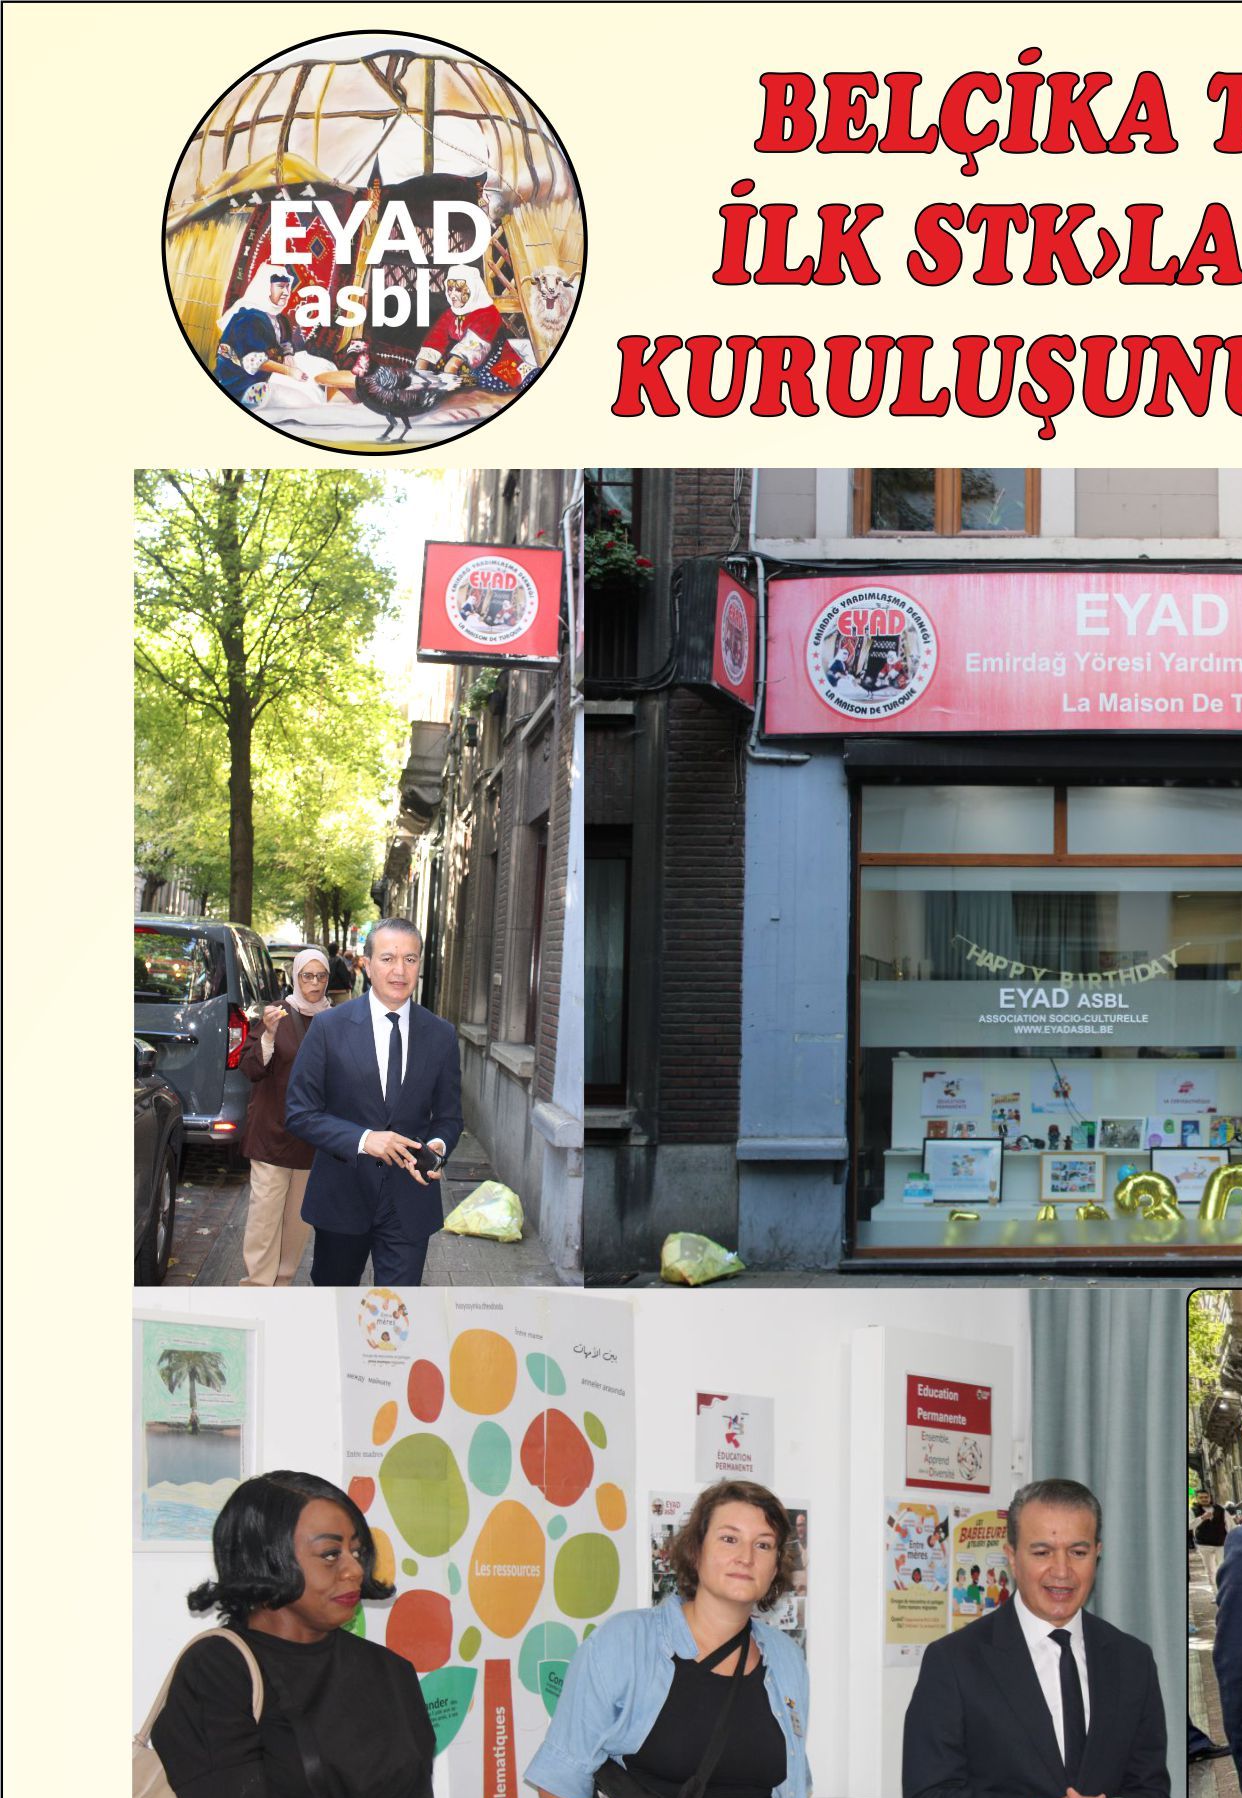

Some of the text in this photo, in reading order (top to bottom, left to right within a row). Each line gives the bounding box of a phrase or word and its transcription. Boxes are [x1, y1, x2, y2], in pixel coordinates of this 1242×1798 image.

[469, 570, 518, 589] EYAD
[838, 608, 905, 635] EYAD
[1075, 593, 1229, 637] EYAD
[965, 652, 1067, 676] Emirdağ
[1071, 652, 1152, 673] Yöresi
[825, 688, 917, 715] LA MAISON DE TURQUIE
[1063, 693, 1090, 713] La
[1099, 693, 1186, 713] Maison
[1192, 694, 1225, 713] De
[966, 944, 1179, 991] HAPPY BIRTHDAY
[999, 988, 1130, 1008] EYAD ASBL
[978, 1014, 1149, 1023] ASSOCIATION SOCIO-CULTURELLE
[1013, 1025, 1114, 1034] WWW.EYADASBL.BE
[917, 1383, 959, 1401] Education
[917, 1407, 968, 1425] Permanente
[717, 1449, 752, 1462] ÉDUCATION
[924, 1454, 949, 1465] Apprend
[715, 1461, 753, 1472] PERMANENTE
[665, 1500, 680, 1508] EYAD
[908, 1540, 924, 1549] Entre
[907, 1550, 928, 1560] mères
[475, 1559, 541, 1577] Les ressources
